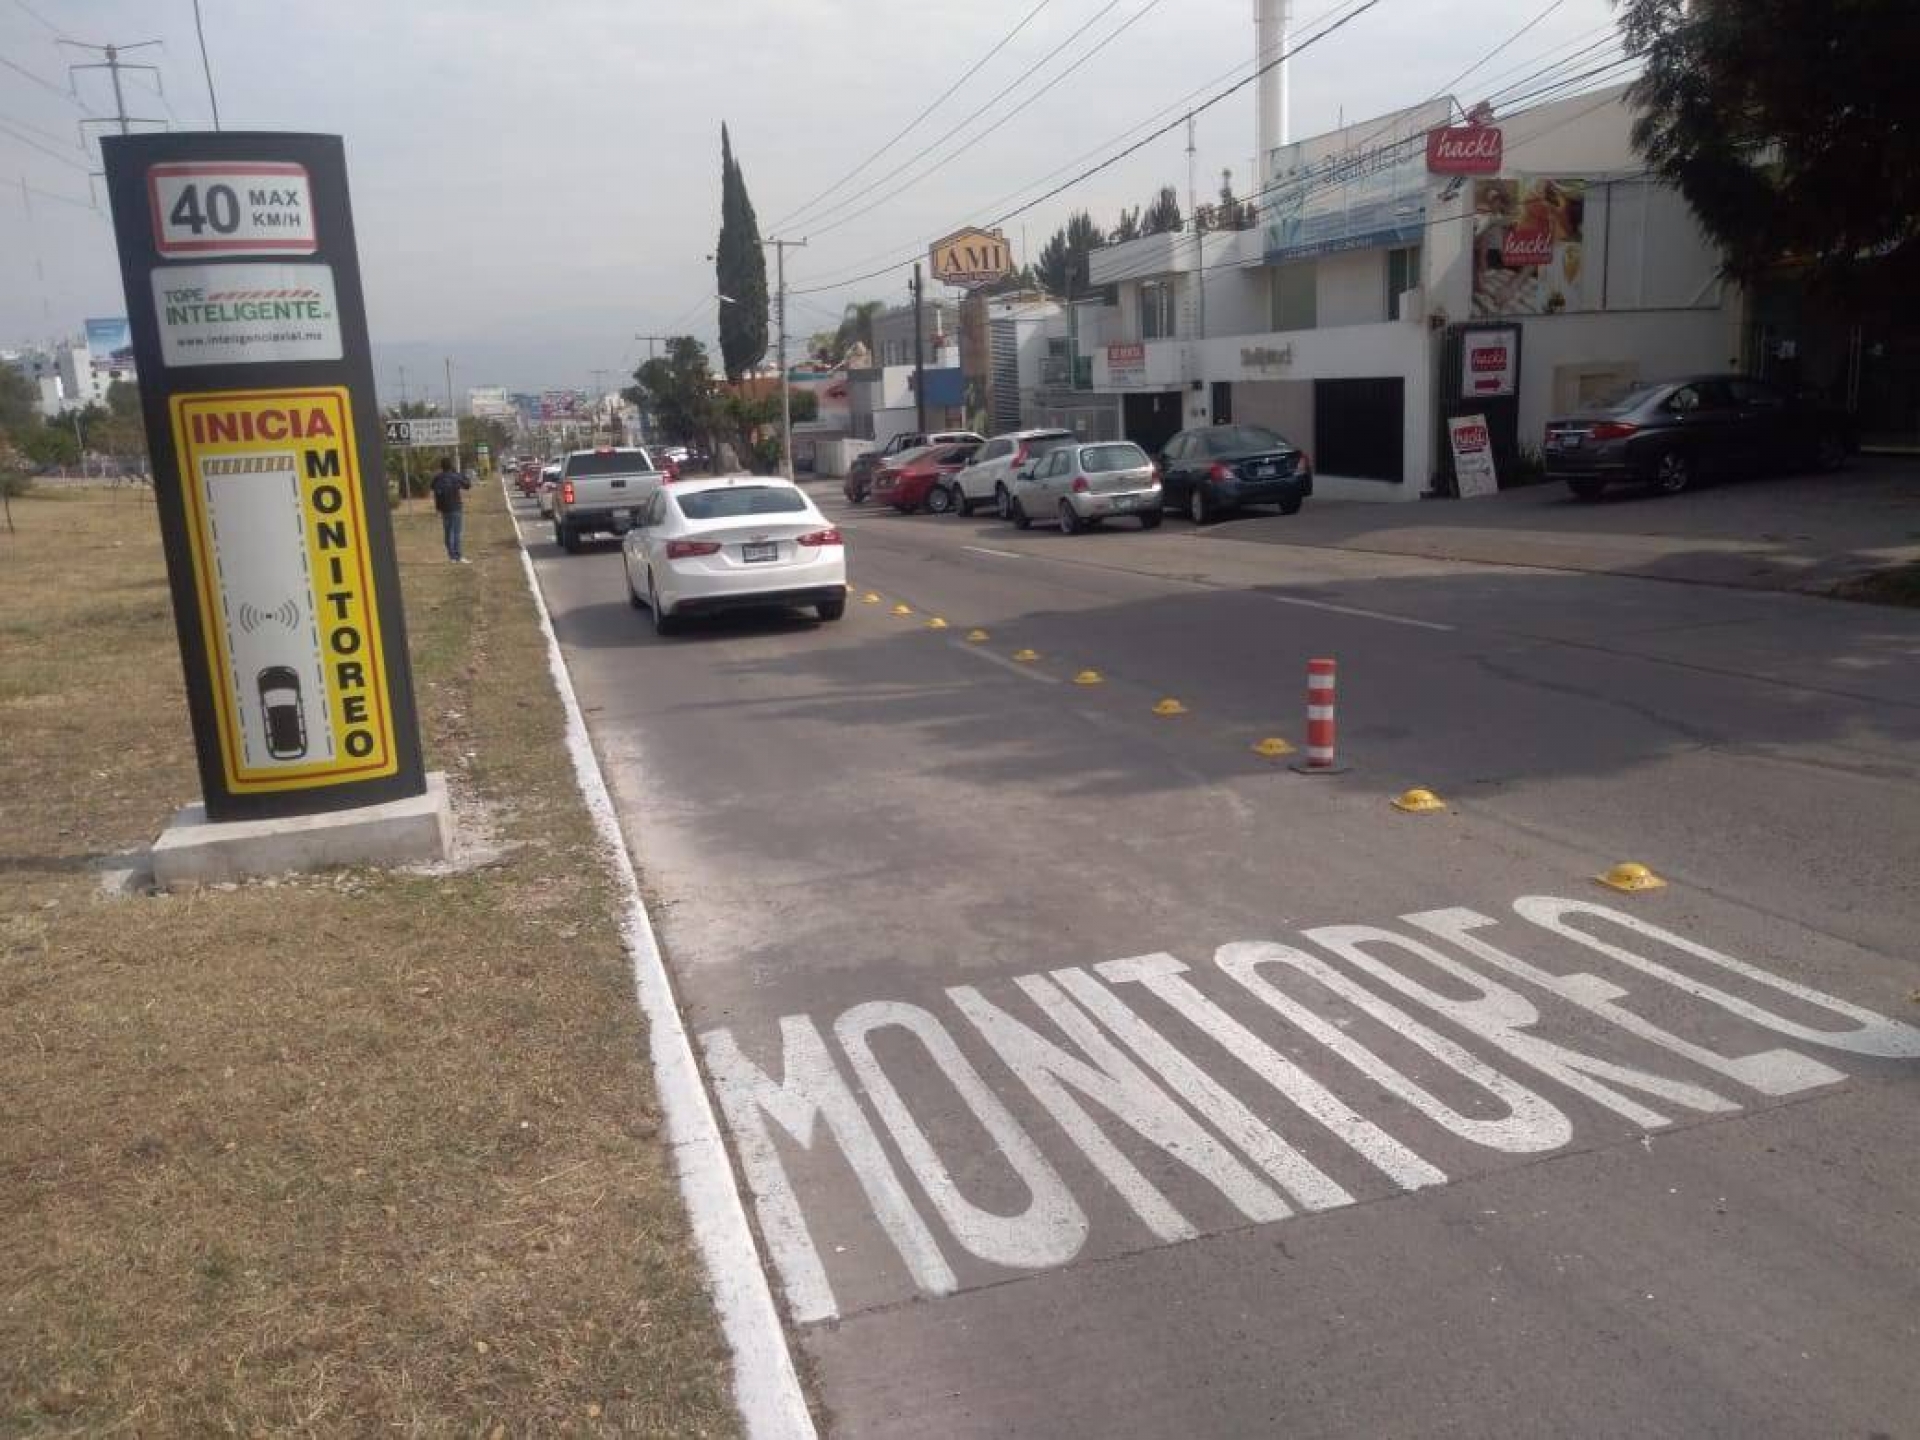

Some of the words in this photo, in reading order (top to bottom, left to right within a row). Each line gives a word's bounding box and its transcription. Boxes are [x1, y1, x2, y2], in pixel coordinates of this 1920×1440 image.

[1436, 133, 1500, 158] hackl
[169, 183, 240, 234] 40
[249, 189, 300, 206] MAX
[252, 212, 301, 227] KM/H
[942, 245, 1001, 272] AMI
[164, 288, 205, 302] TOPE
[166, 301, 323, 326] INTELIGENTE
[191, 408, 335, 444] INICIA
[386, 424, 410, 439] 40
[304, 449, 374, 758] MONITOREO
[696, 894, 1920, 1323] MONITOREO
